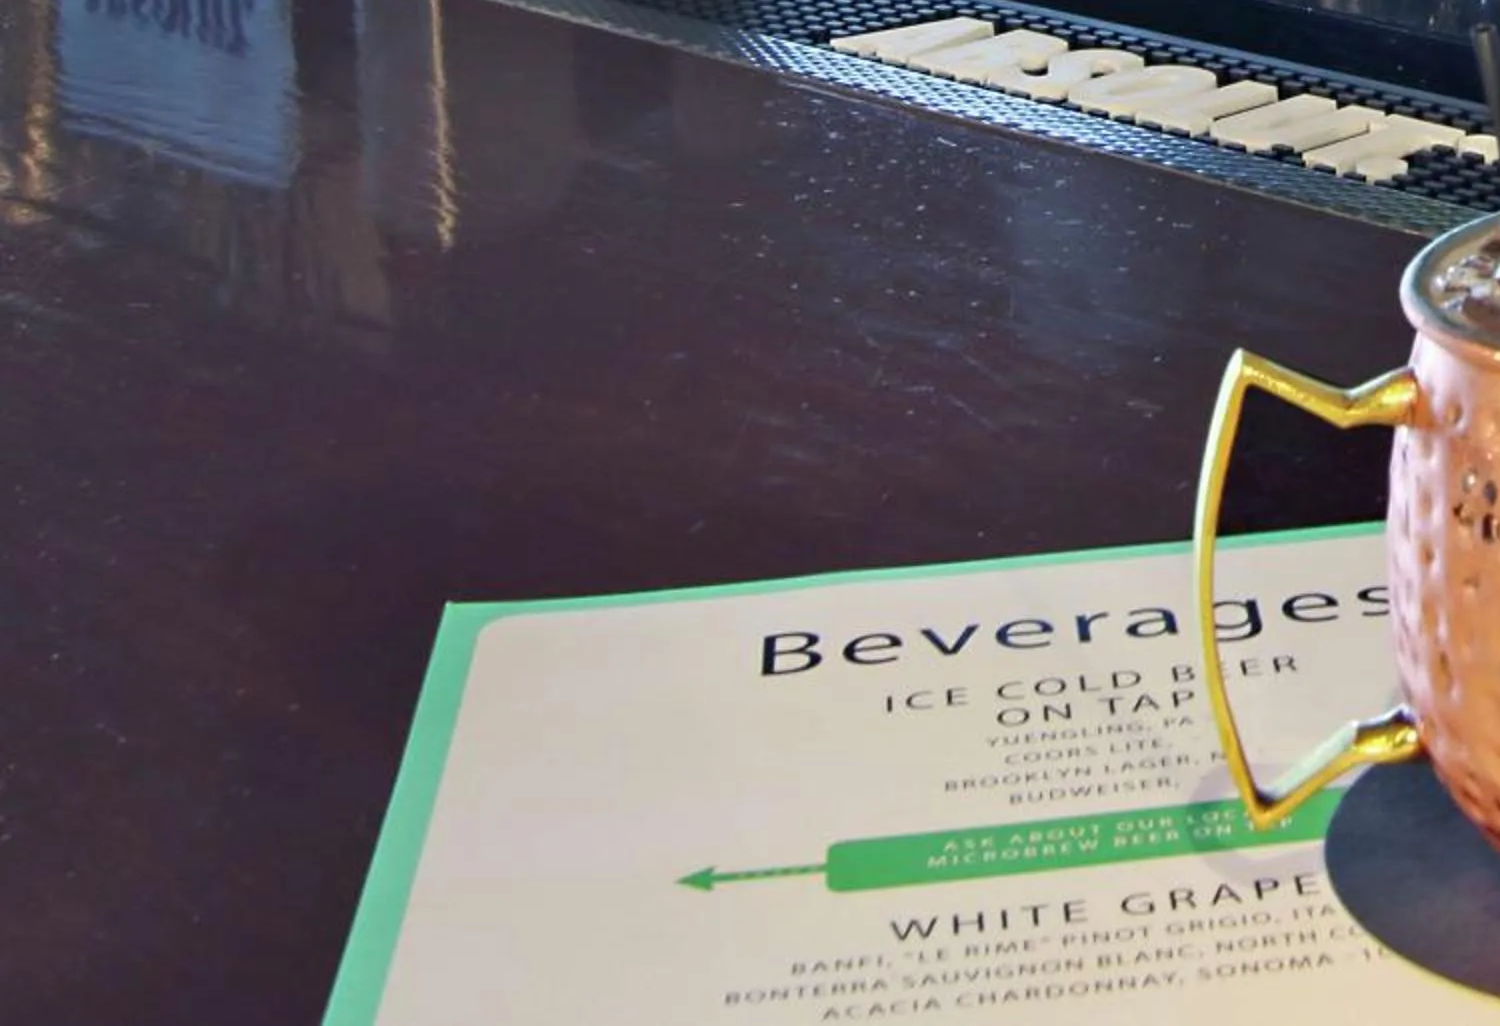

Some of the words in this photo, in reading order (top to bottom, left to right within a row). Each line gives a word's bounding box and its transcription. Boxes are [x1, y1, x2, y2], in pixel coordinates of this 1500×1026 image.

[761, 585, 1391, 676] Beverages
[885, 686, 969, 713] ICE
[996, 669, 1142, 702] COLD
[1172, 654, 1298, 683] BER
[995, 703, 1073, 727] ON
[1099, 690, 1196, 716] TAP
[1163, 716, 1194, 728] PA
[1004, 743, 1099, 765] COORS
[944, 765, 1093, 793] BROOKLYN
[926, 839, 1099, 869] MICROBREW
[1113, 829, 1181, 848] BEER
[1192, 824, 1232, 839] ON
[942, 835, 997, 852] ASK
[1009, 824, 1101, 846] ABOUT
[1115, 816, 1175, 833] OUR
[889, 896, 1089, 943] WHITE
[1060, 924, 1150, 948] PINOT
[1291, 904, 1337, 922] ITA
[723, 977, 889, 1006] BONTERRA
[901, 956, 1085, 988] SAUVIGNON
[1215, 929, 1317, 954] NORTH
[821, 997, 943, 1021] ACACIA
[1199, 954, 1334, 984] SONOMA
